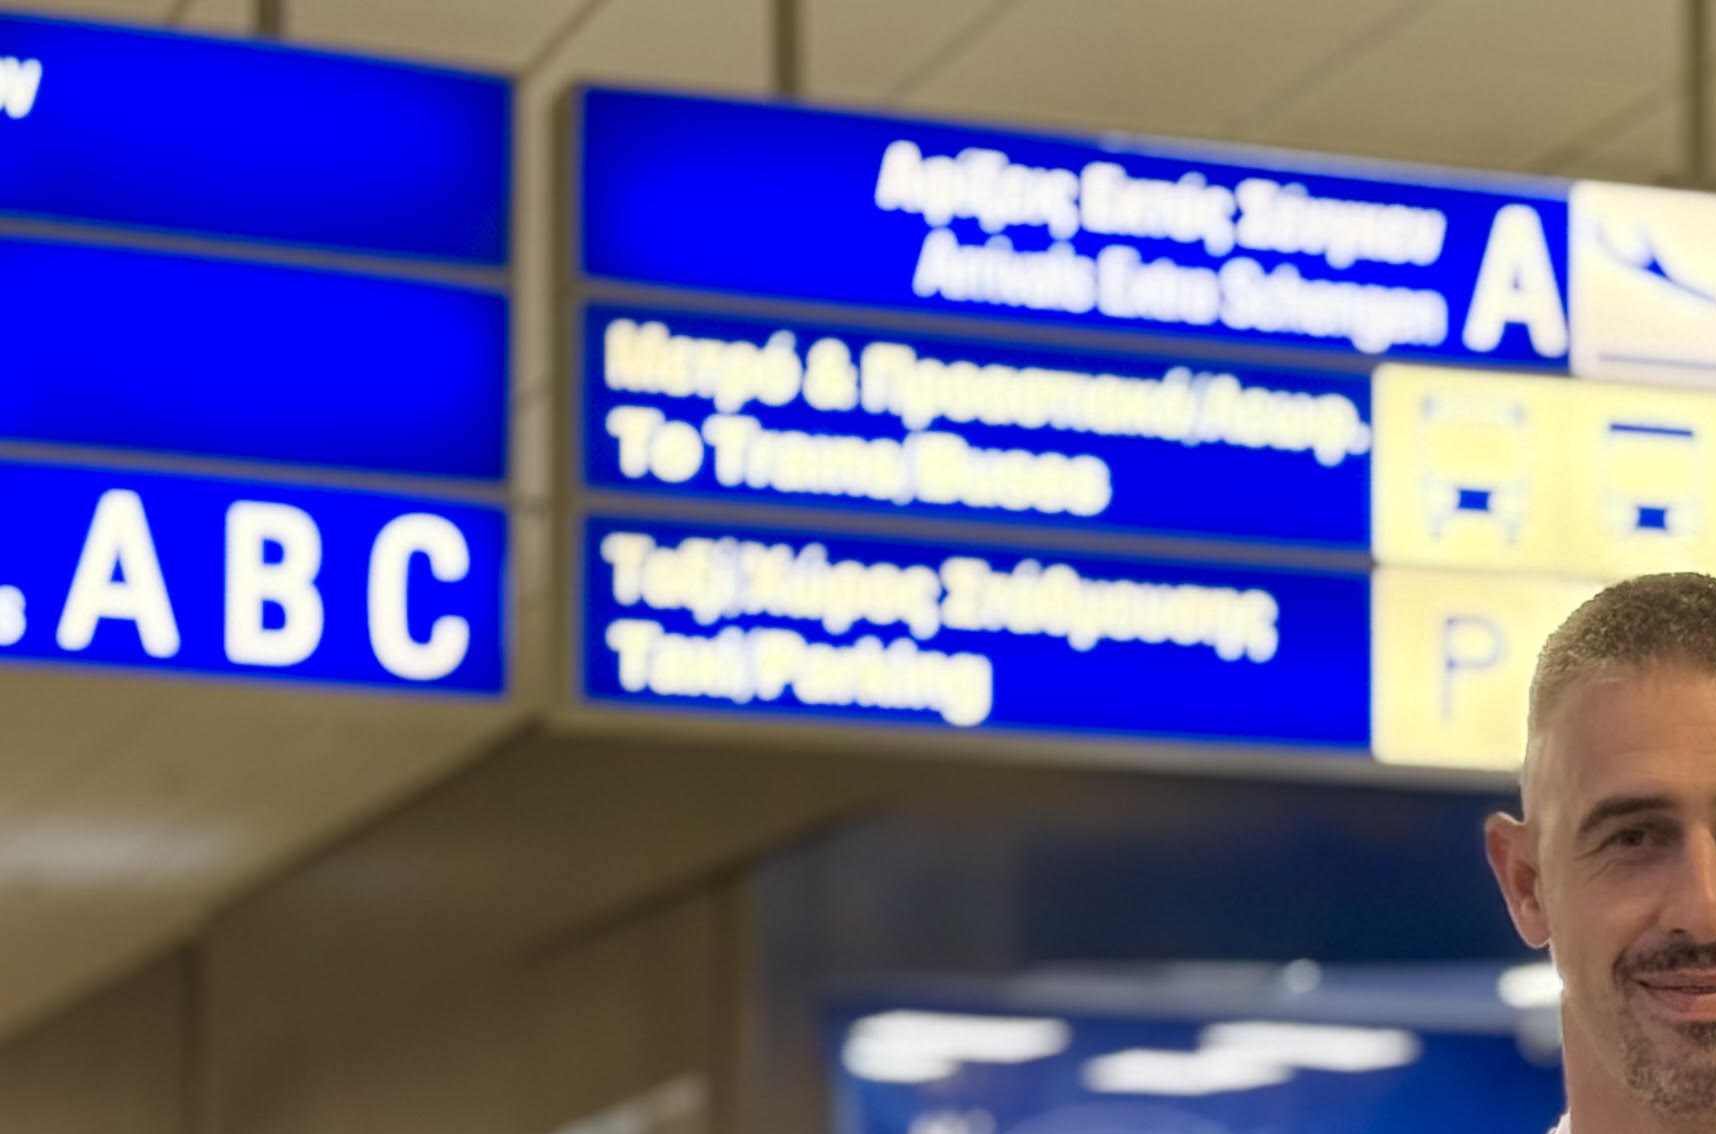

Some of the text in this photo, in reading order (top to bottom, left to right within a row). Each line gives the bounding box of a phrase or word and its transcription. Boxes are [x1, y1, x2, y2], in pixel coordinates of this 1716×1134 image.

[55, 487, 471, 682] A B C
[1442, 614, 1503, 722] P
